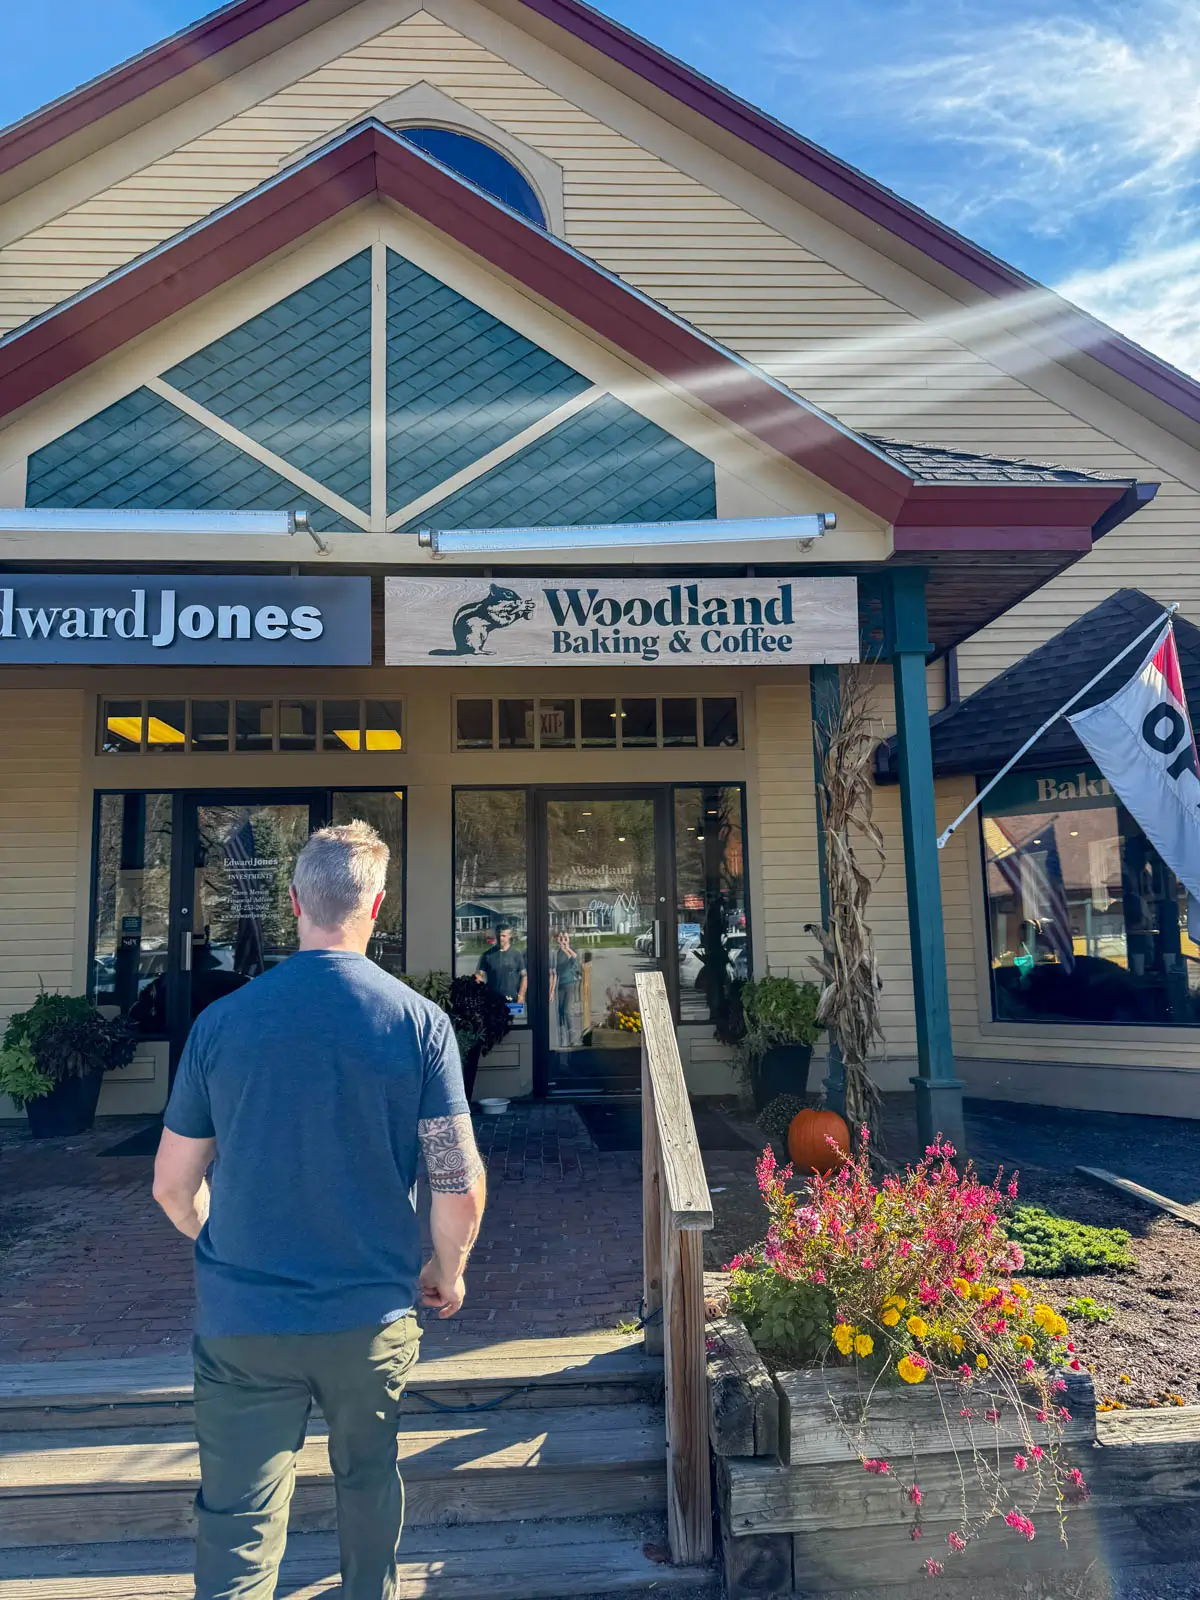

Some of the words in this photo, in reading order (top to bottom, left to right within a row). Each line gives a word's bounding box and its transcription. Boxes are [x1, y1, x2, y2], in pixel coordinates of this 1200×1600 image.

[152, 589, 324, 647] Jones
[542, 584, 795, 627] Woodland
[552, 628, 660, 661] Baking
[669, 630, 692, 653] &
[701, 628, 793, 653] Coffee
[571, 864, 632, 875] Woodland
